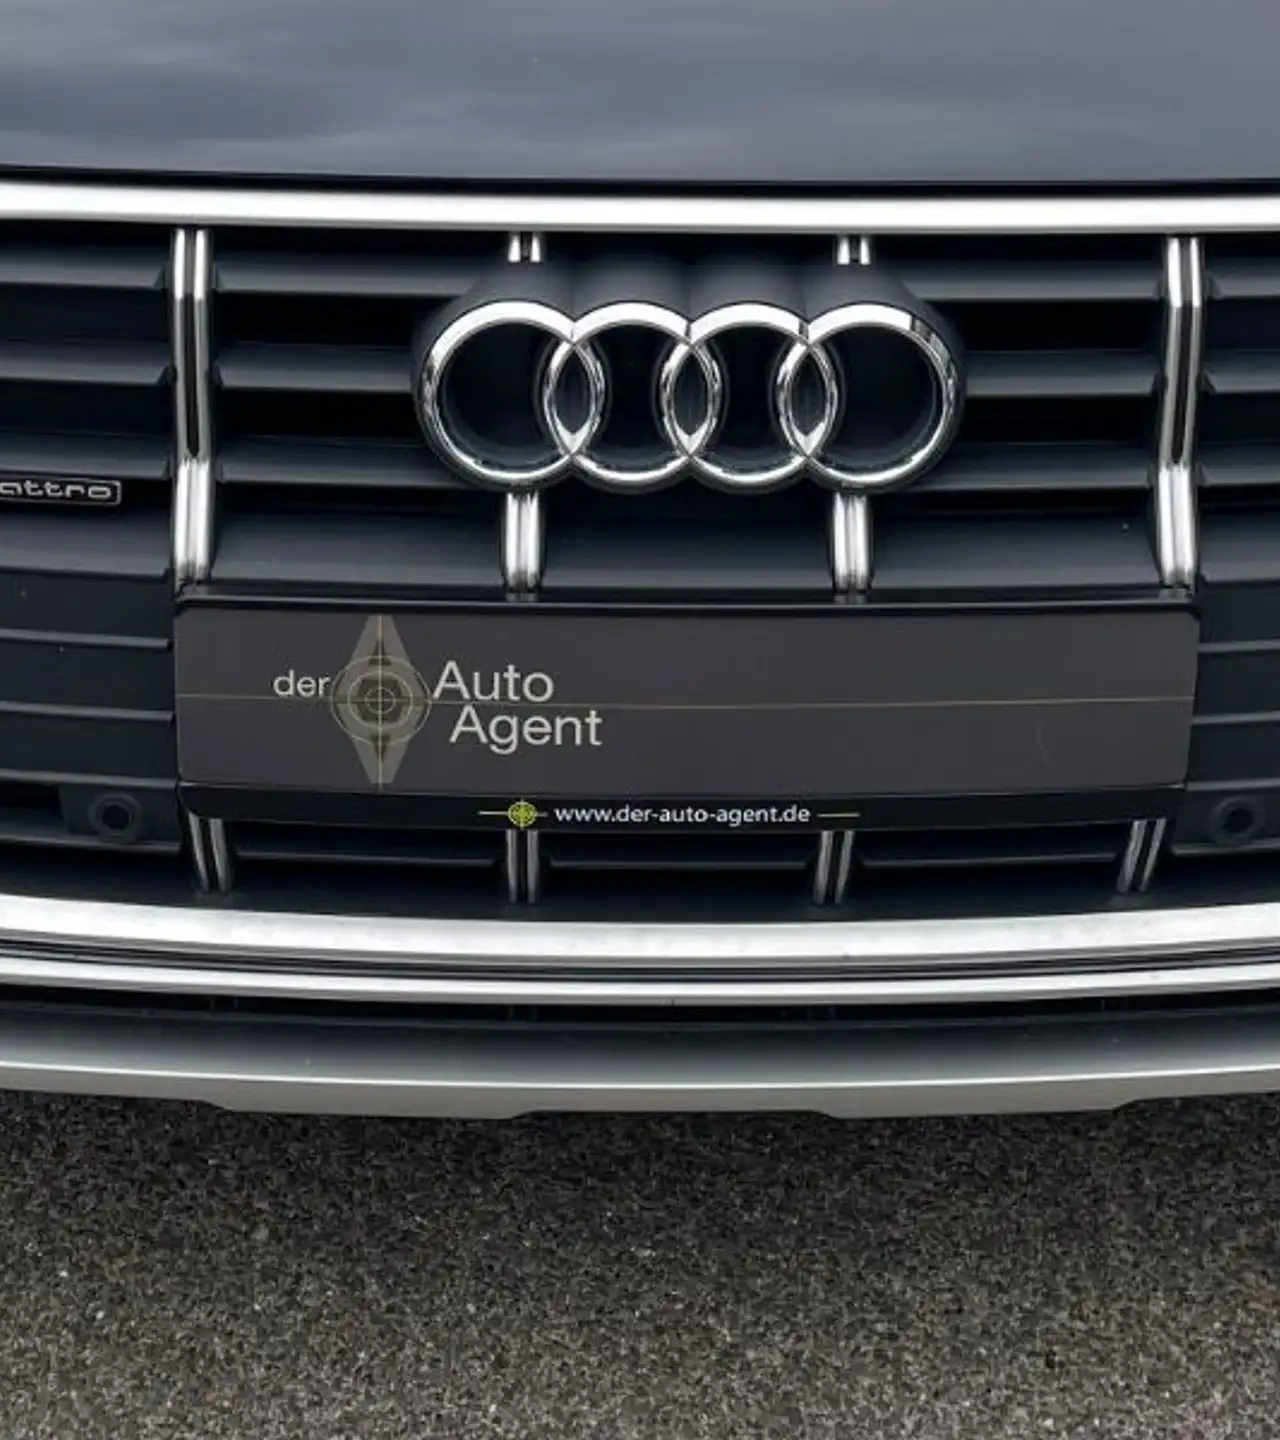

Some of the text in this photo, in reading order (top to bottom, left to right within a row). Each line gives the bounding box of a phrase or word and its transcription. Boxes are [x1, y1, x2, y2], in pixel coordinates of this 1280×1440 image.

[272, 660, 555, 702] der Auto
[449, 704, 603, 755] Agent
[555, 803, 811, 827] www.der-auto-agent.de
